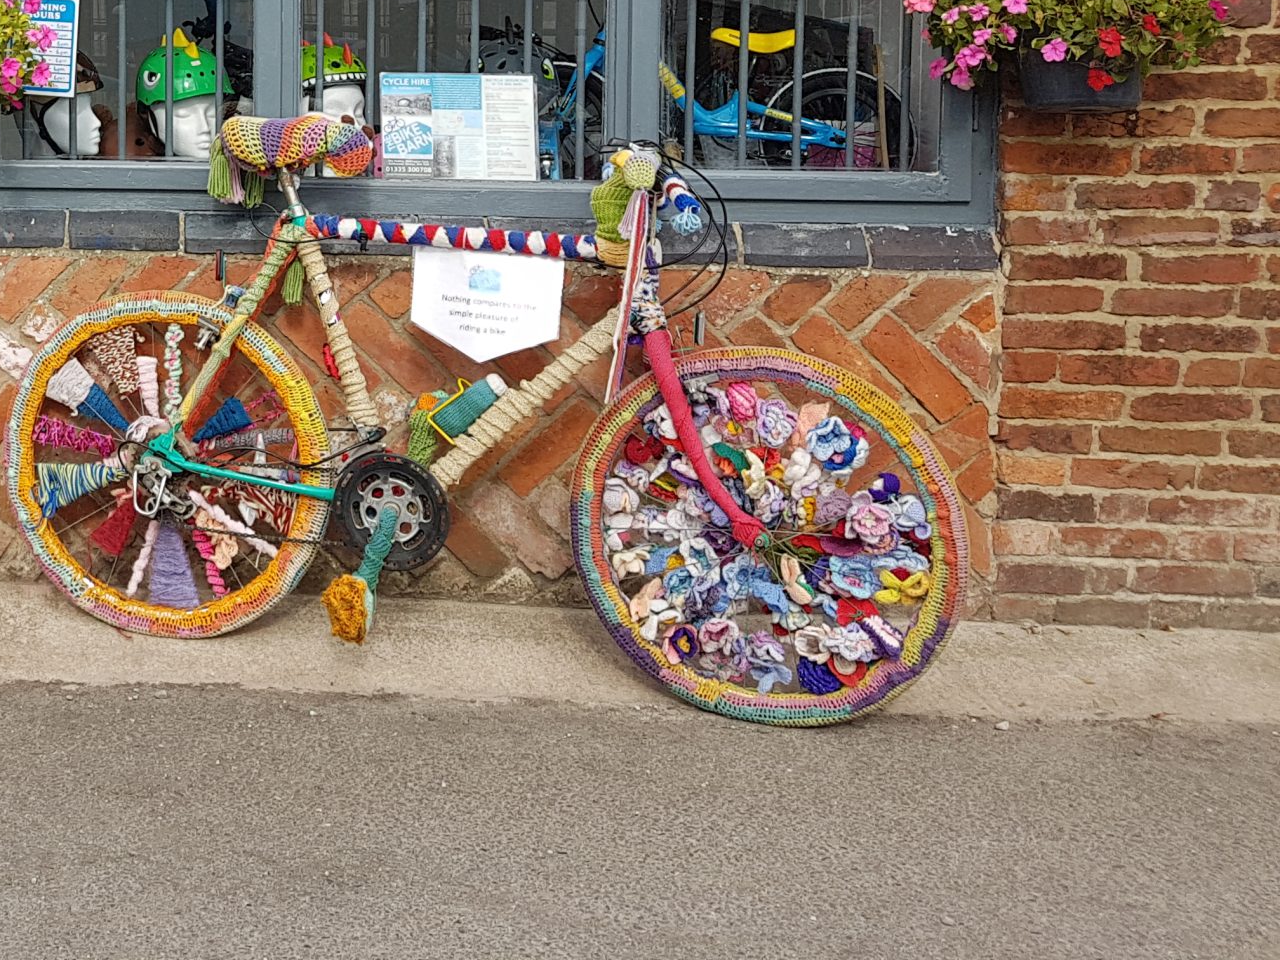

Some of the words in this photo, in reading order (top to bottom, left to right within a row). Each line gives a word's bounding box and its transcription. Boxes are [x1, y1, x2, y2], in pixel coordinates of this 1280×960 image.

[383, 78, 409, 86] CYCLE
[411, 78, 431, 86] HIRE
[391, 122, 422, 143] BIKE
[397, 132, 432, 155] BARN
[441, 294, 471, 305] Nothing
[473, 299, 511, 309] compares
[523, 303, 537, 311] the
[449, 309, 473, 318] simple
[475, 311, 508, 321] pleasure
[459, 323, 481, 334] riding
[489, 327, 506, 335] bike
